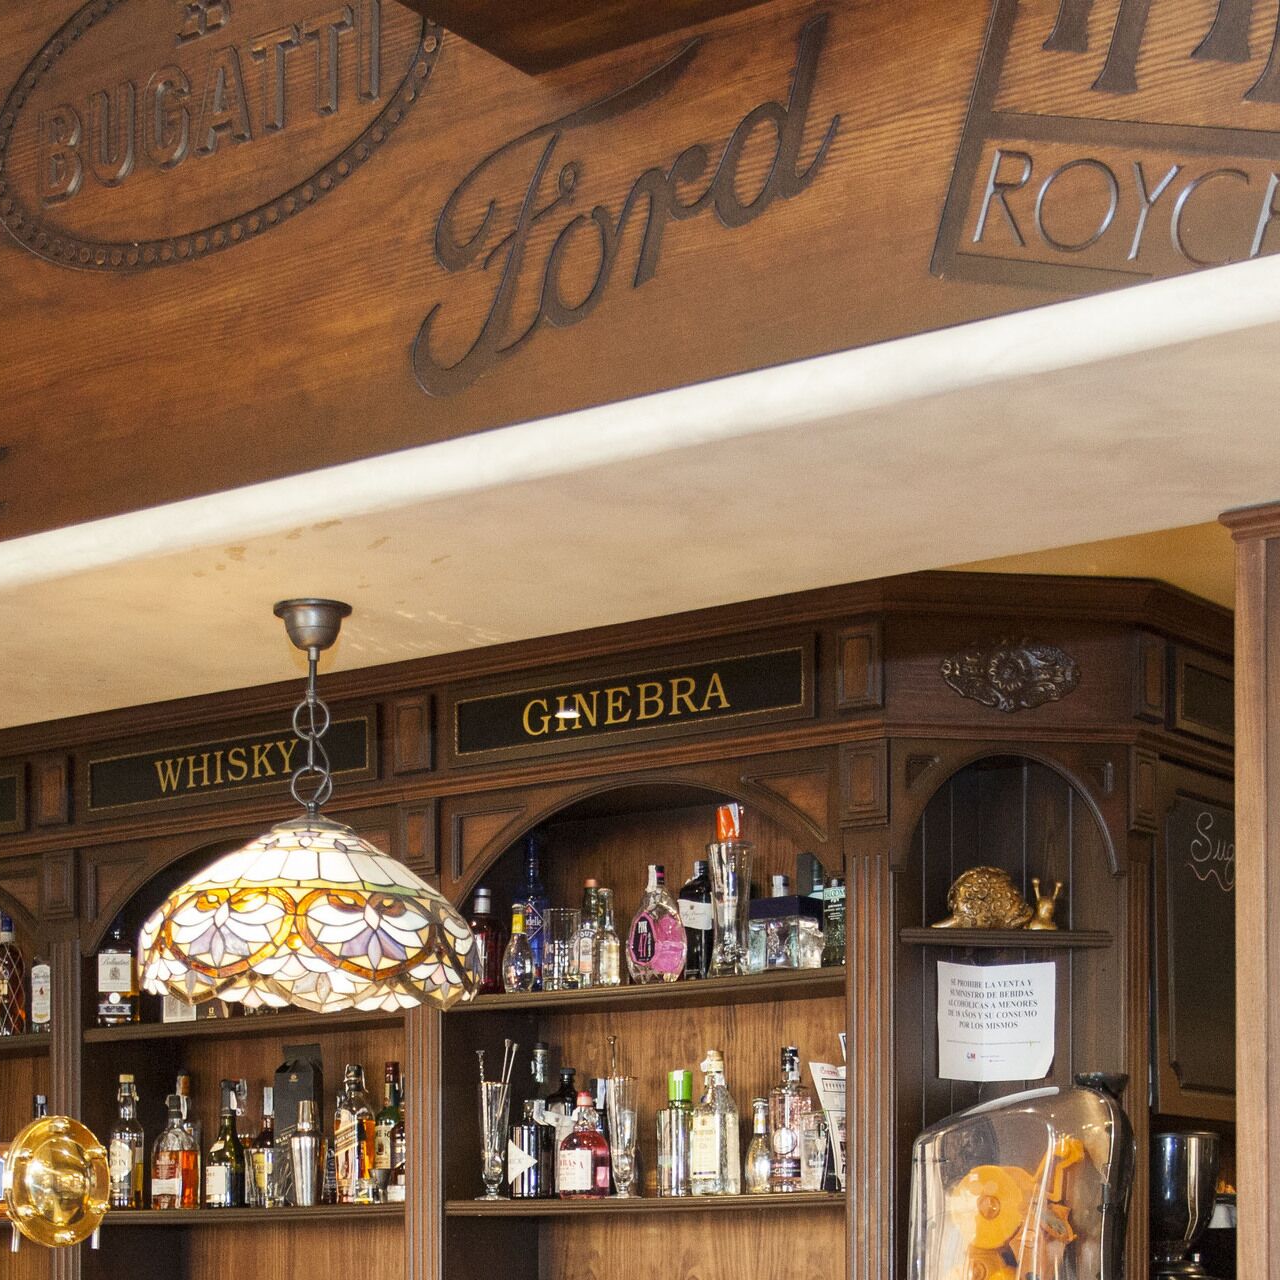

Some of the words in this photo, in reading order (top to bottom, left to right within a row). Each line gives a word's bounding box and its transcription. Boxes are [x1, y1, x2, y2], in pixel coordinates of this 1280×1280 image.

[36, 0, 383, 204] BUGATTI
[410, 12, 842, 399] Ford
[522, 672, 731, 736] GINEBRA
[154, 738, 299, 793] WHISKY
[998, 980, 1025, 988] VENTA
[999, 990, 1034, 998] BEBIDAS
[998, 1000, 1038, 1008] MENORES
[996, 1010, 1038, 1019] CONSUMO
[986, 1021, 1018, 1029] MISMOS
